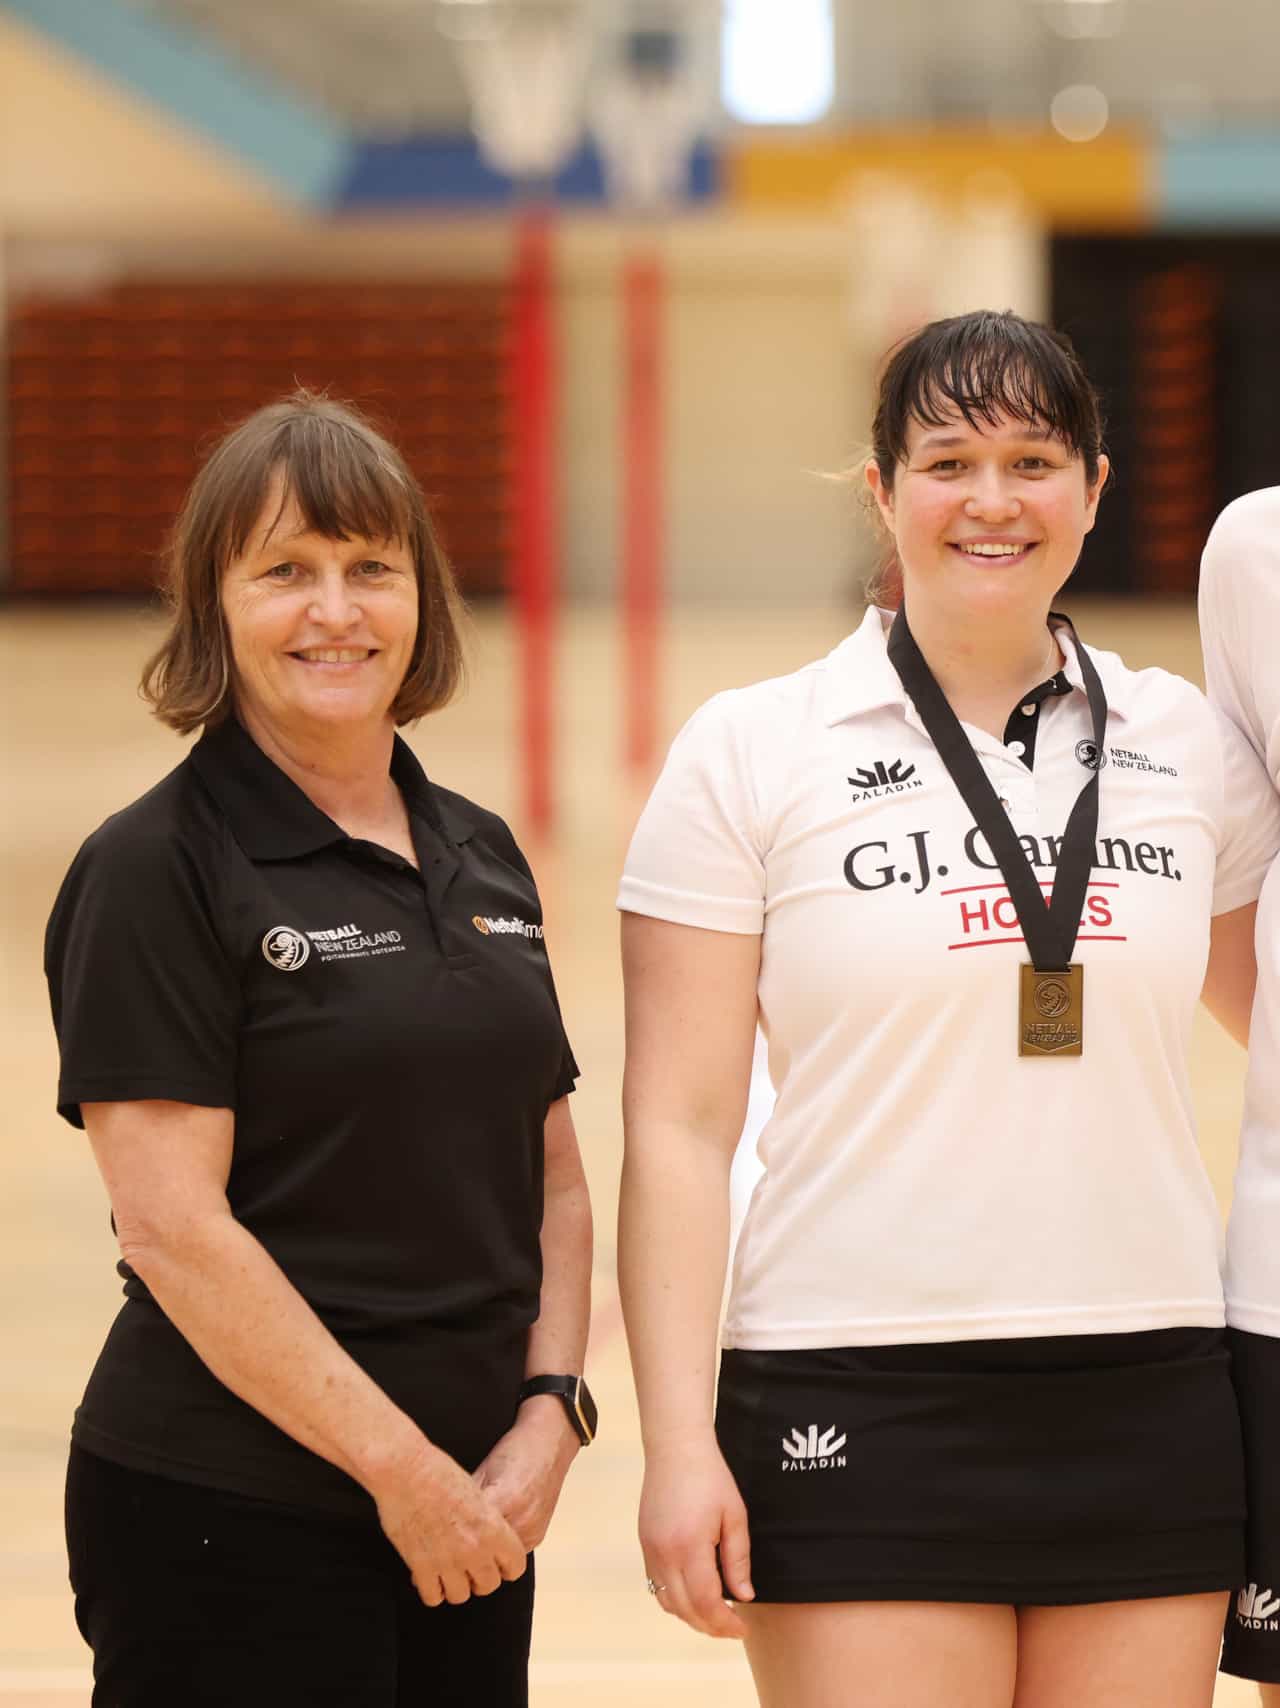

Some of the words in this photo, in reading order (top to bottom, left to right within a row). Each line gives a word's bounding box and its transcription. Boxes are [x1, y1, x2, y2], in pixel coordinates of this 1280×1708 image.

[1110, 747, 1150, 762] NETBALL
[1112, 759, 1134, 769] NEW
[1136, 761, 1178, 777] ZEALAND
[851, 779, 923, 804] PALADIN
[843, 830, 949, 895] G.J.
[959, 895, 1113, 934] HOS
[305, 922, 363, 941] NETBALL
[313, 941, 343, 953] NEW
[342, 929, 402, 951] ZEALAND
[781, 1455, 847, 1472] PALADIN
